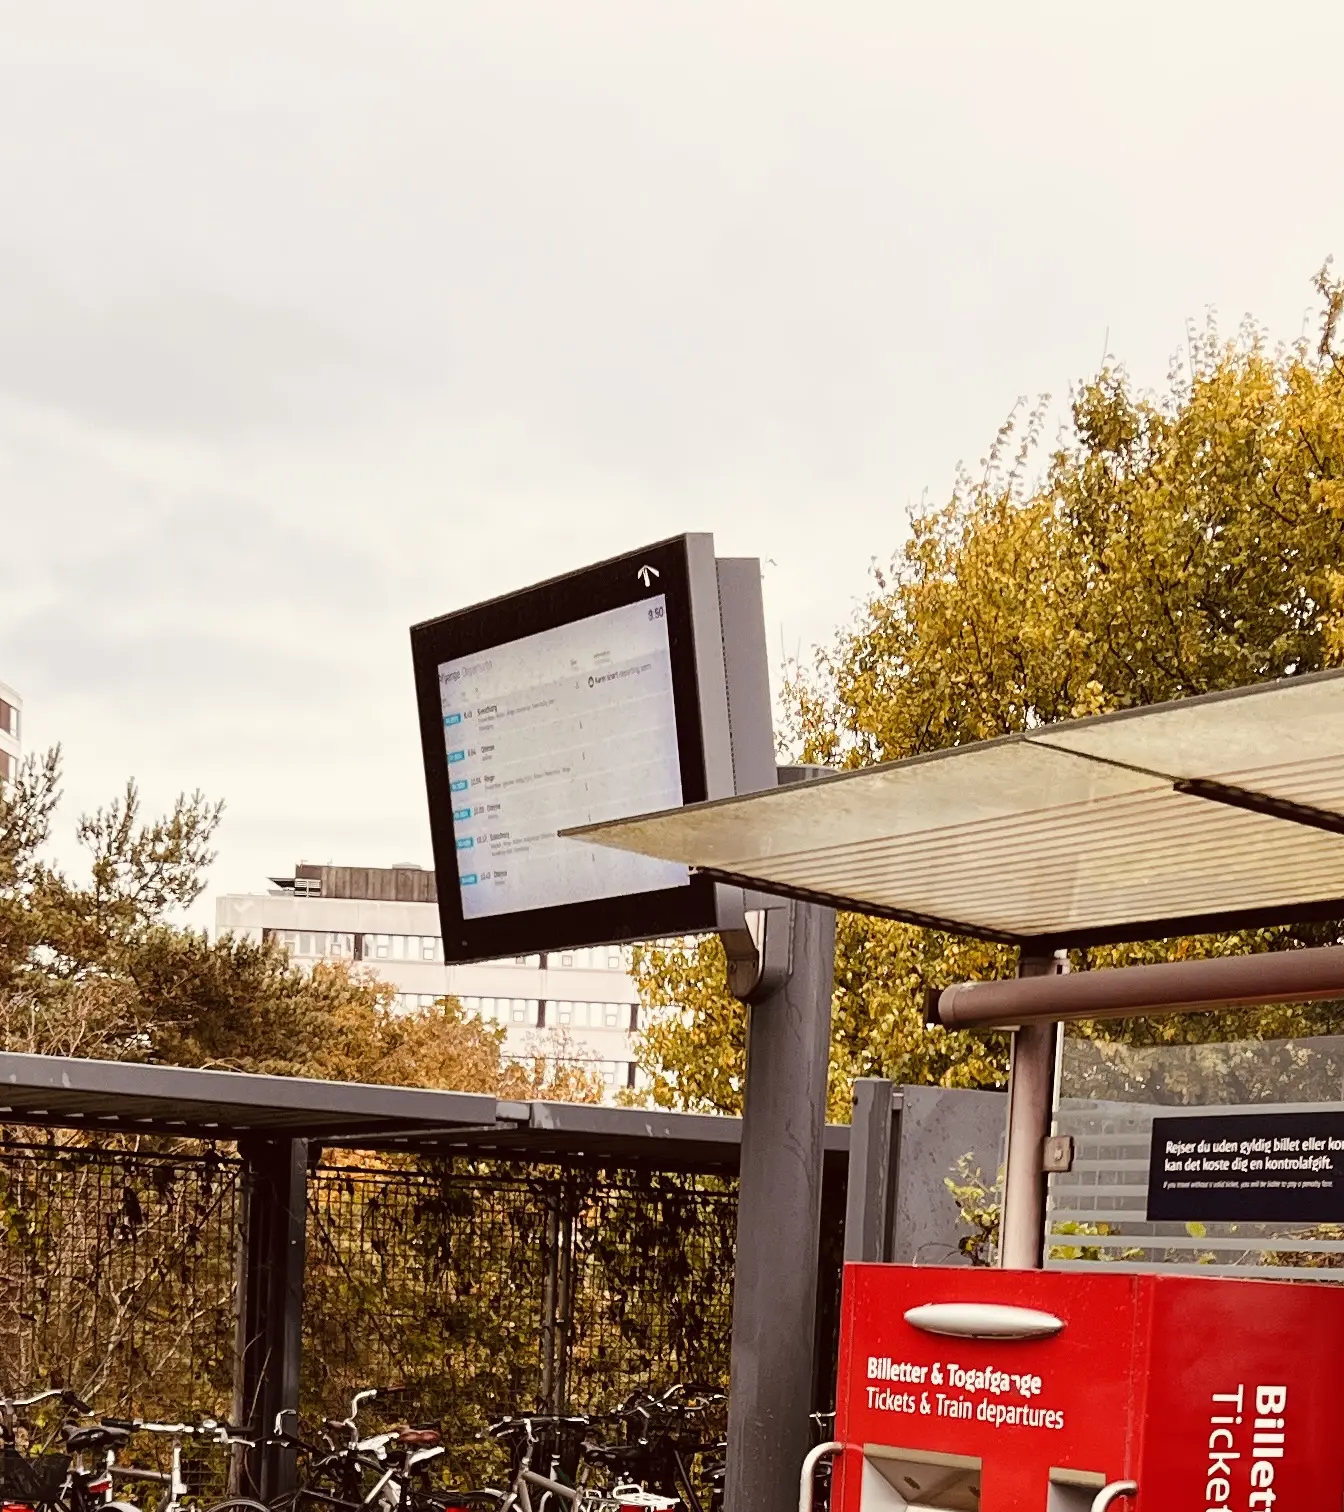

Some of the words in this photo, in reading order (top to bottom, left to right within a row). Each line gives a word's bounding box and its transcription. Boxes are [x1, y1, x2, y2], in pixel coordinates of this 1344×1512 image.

[1165, 1140, 1197, 1156] Rejser
[1197, 1139, 1211, 1153] du
[1212, 1139, 1238, 1153] uden
[1239, 1138, 1272, 1155] gyldig
[1273, 1137, 1300, 1152] billet
[1301, 1136, 1326, 1151] eller
[1164, 1158, 1183, 1172] kan
[1184, 1157, 1201, 1171] det
[1202, 1157, 1230, 1171] koste
[1231, 1157, 1248, 1172] dig
[1249, 1159, 1263, 1171] en
[1264, 1155, 1333, 1172] kontrolafgift.
[867, 1356, 928, 1384] Billetter
[930, 1362, 944, 1386] &
[866, 1386, 916, 1414] Tickets
[919, 1391, 931, 1415] &
[935, 1394, 973, 1419] Train
[976, 1398, 1065, 1429] departures
